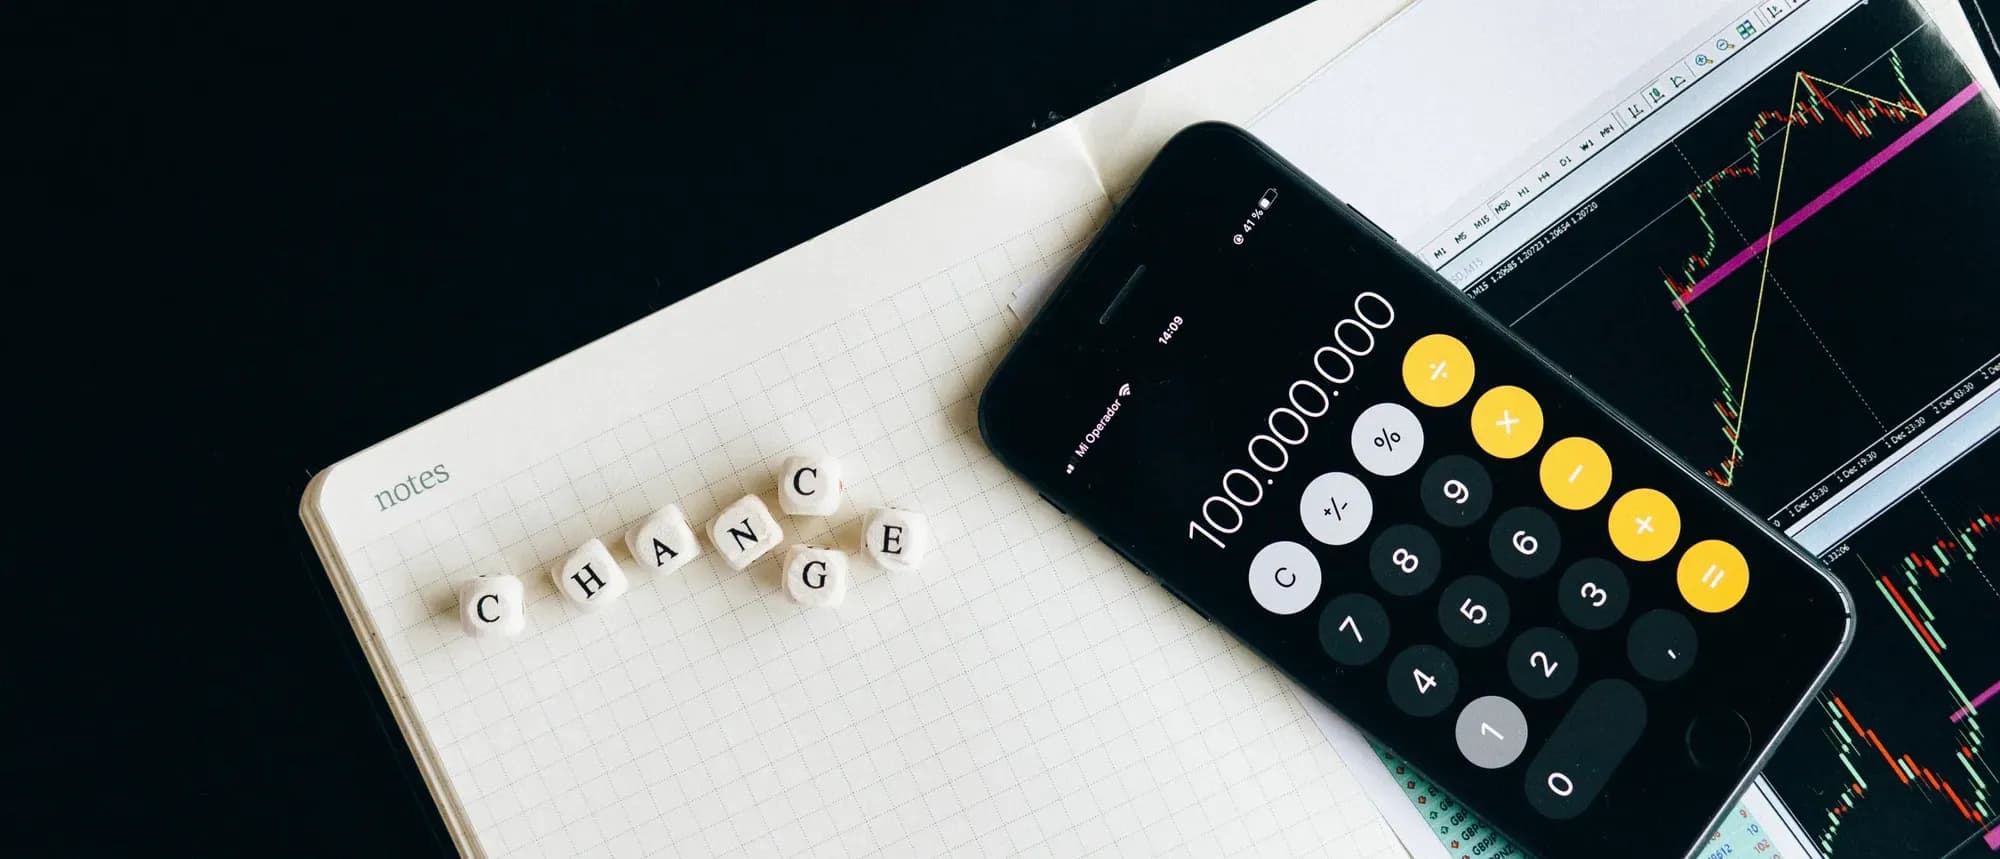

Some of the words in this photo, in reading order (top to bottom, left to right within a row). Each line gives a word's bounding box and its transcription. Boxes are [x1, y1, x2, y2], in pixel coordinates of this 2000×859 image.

[1243, 218, 1256, 233] 41
[1251, 207, 1264, 220] %
[1473, 214, 1490, 229] M15
[1158, 315, 1183, 345] 14:09
[1074, 441, 1089, 458] Mi
[1085, 397, 1122, 444] Operador
[1188, 291, 1395, 549] 100.000.000
[373, 462, 451, 513] notes
[1442, 478, 1470, 505] 9
[1511, 529, 1539, 556] 6
[1391, 547, 1420, 575] 8
[1273, 566, 1298, 590] C
[1579, 581, 1608, 608] 3
[1458, 598, 1489, 626] 5
[1337, 614, 1365, 644] 7
[1529, 650, 1560, 679] 2
[1412, 667, 1438, 696] 4
[1480, 721, 1505, 742] 1
[1546, 771, 1575, 798] 0
